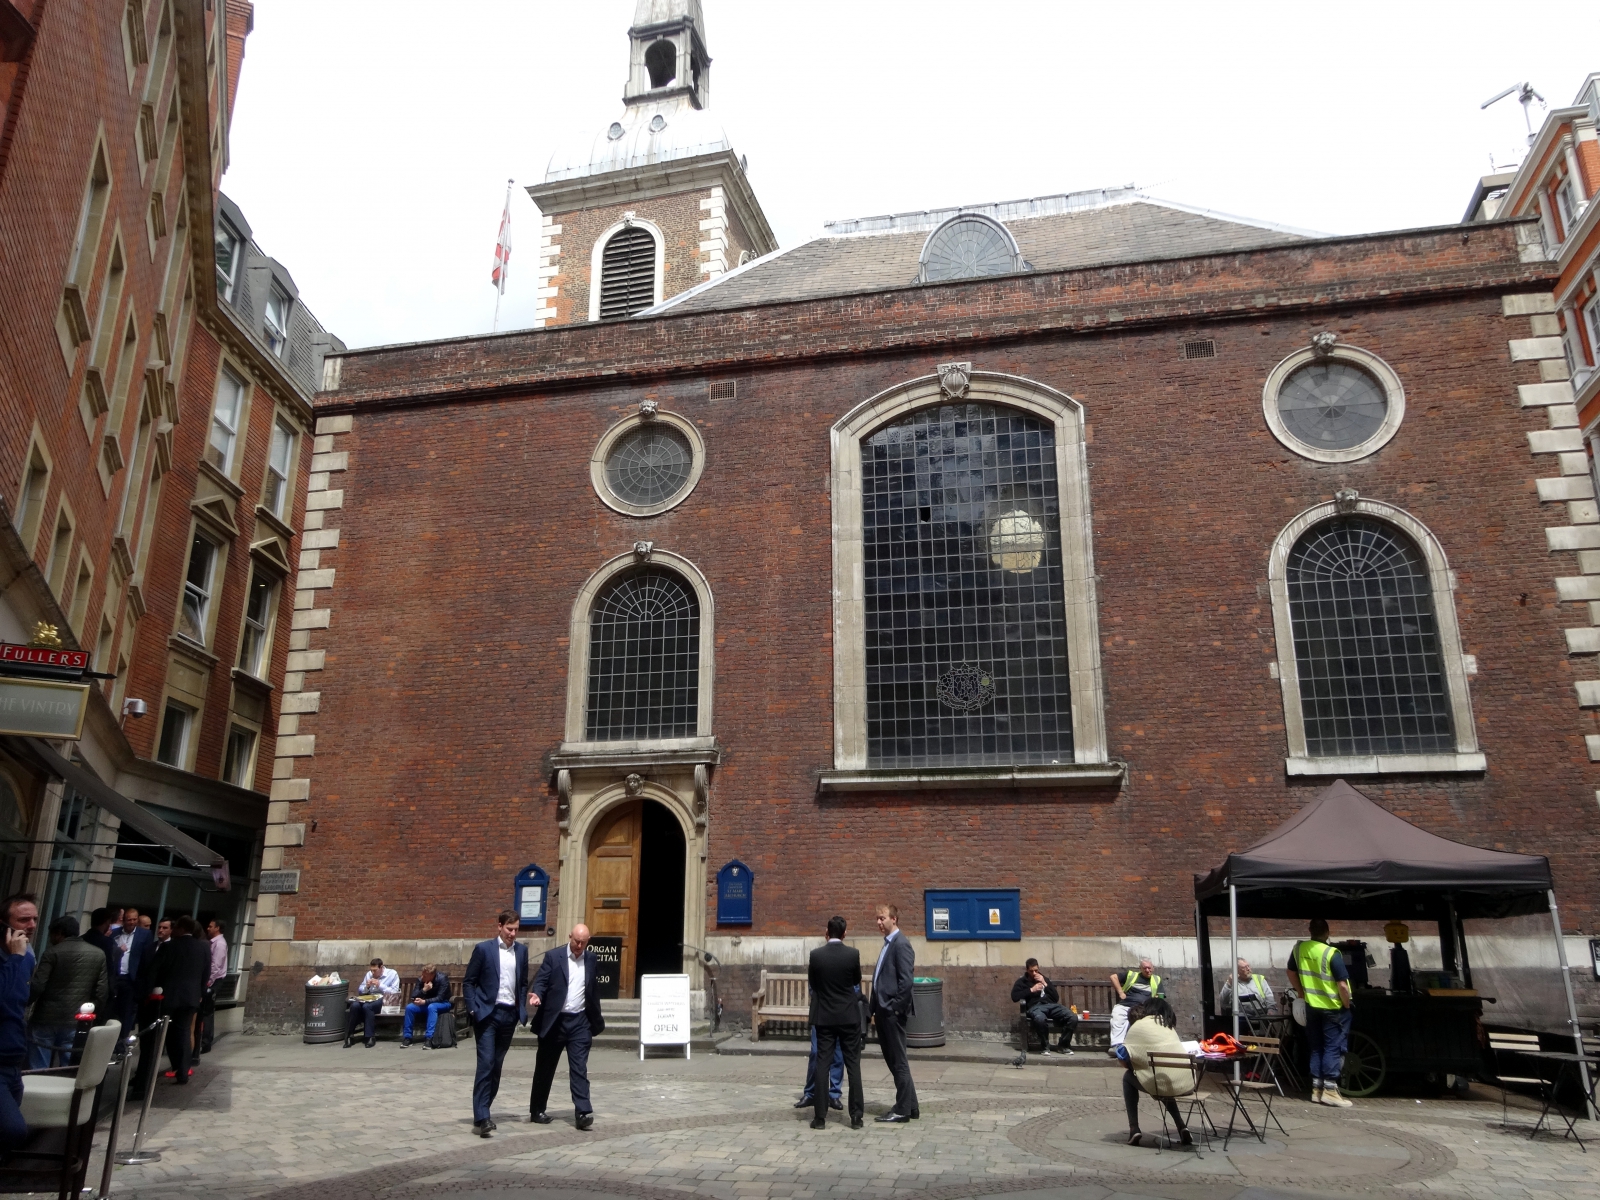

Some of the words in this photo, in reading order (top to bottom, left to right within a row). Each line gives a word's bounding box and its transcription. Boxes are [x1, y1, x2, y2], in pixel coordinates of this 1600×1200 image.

[3, 647, 82, 665] FULLER'S
[0, 697, 16, 711] HE
[21, 698, 77, 715] VINTRY
[586, 944, 617, 953] ORGAN
[597, 954, 619, 962] CITAL
[596, 975, 610, 983] :30
[653, 1023, 679, 1032] OPEN
